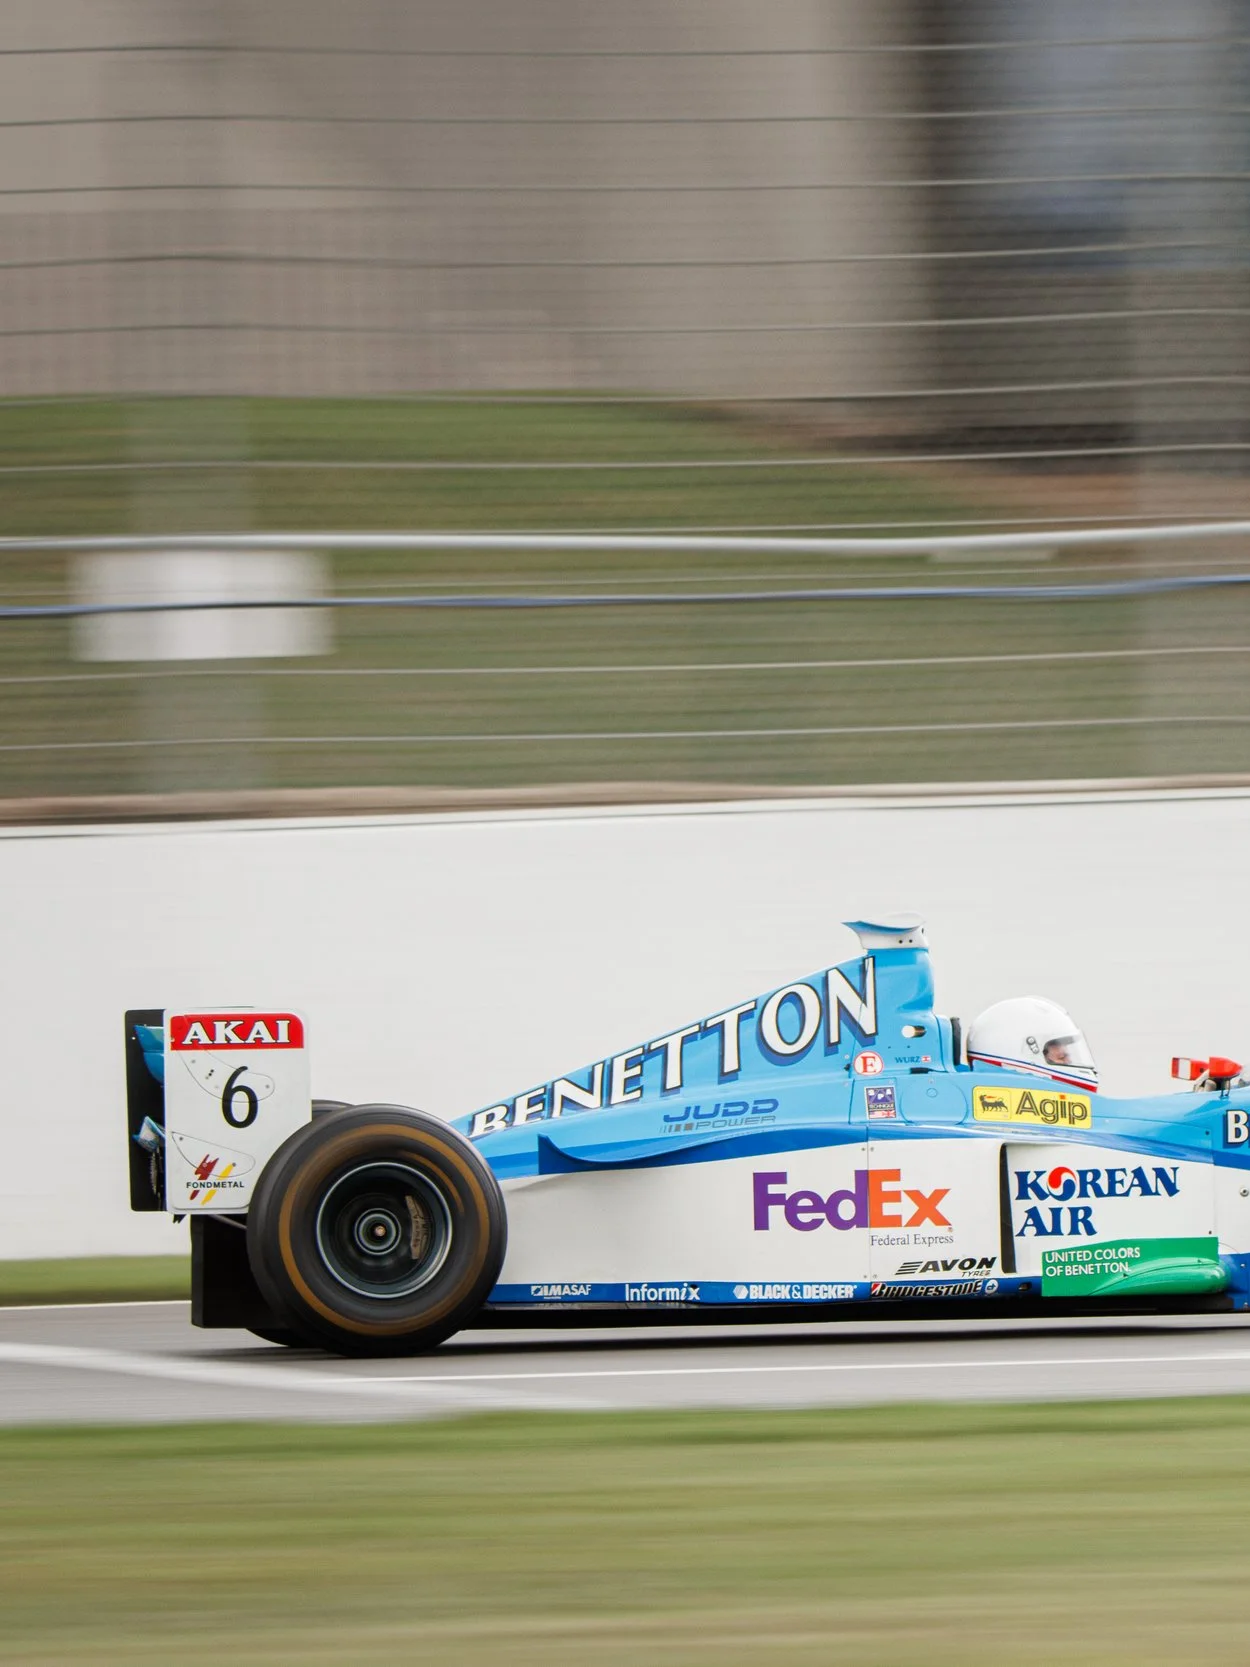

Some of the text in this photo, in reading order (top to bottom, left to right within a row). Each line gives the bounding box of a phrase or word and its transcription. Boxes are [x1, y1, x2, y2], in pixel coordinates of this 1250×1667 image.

[182, 1020, 291, 1045] AKAI
[468, 955, 878, 1138] BENETTON
[861, 1056, 877, 1073] E
[222, 1066, 258, 1129] 6
[663, 1099, 779, 1122] JUDD
[1015, 1091, 1088, 1125] Agip
[696, 1115, 776, 1130] POWER
[186, 1181, 245, 1189] FONDMETAL
[1014, 1166, 1180, 1201] KOREAN
[753, 1169, 952, 1231] FedEx
[1015, 1206, 1097, 1237] AIR
[870, 1233, 954, 1248] Federal Express
[1045, 1247, 1141, 1264] UNITED COLORS
[919, 1256, 998, 1274] AVON
[961, 1270, 991, 1278] TYRES
[1045, 1264, 1065, 1277] OF
[625, 1283, 700, 1301] Informix
[870, 1279, 985, 1297] BRIDGESTONE
